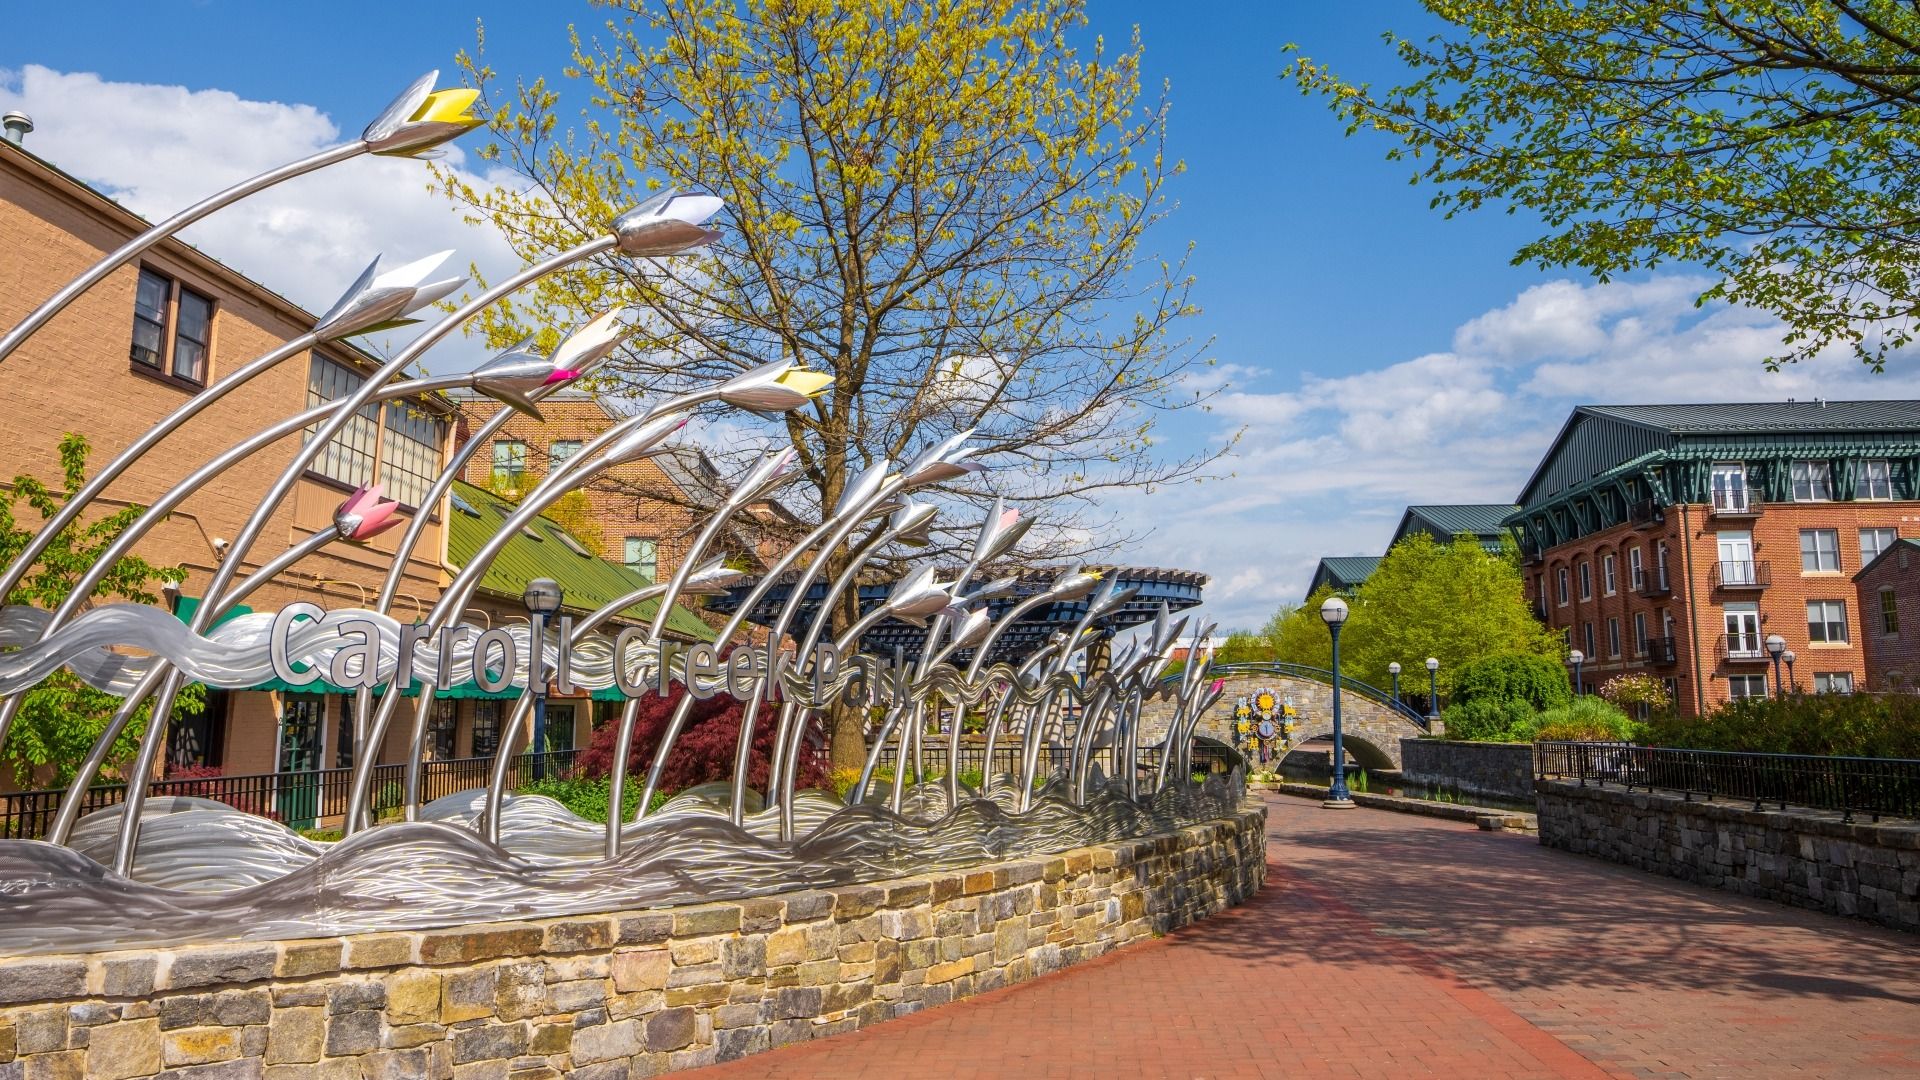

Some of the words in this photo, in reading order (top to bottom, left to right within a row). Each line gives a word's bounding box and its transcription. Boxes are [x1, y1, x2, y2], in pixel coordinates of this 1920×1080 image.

[270, 602, 575, 695] Carroll
[613, 626, 793, 703] Creek
[814, 642, 916, 709] Park
